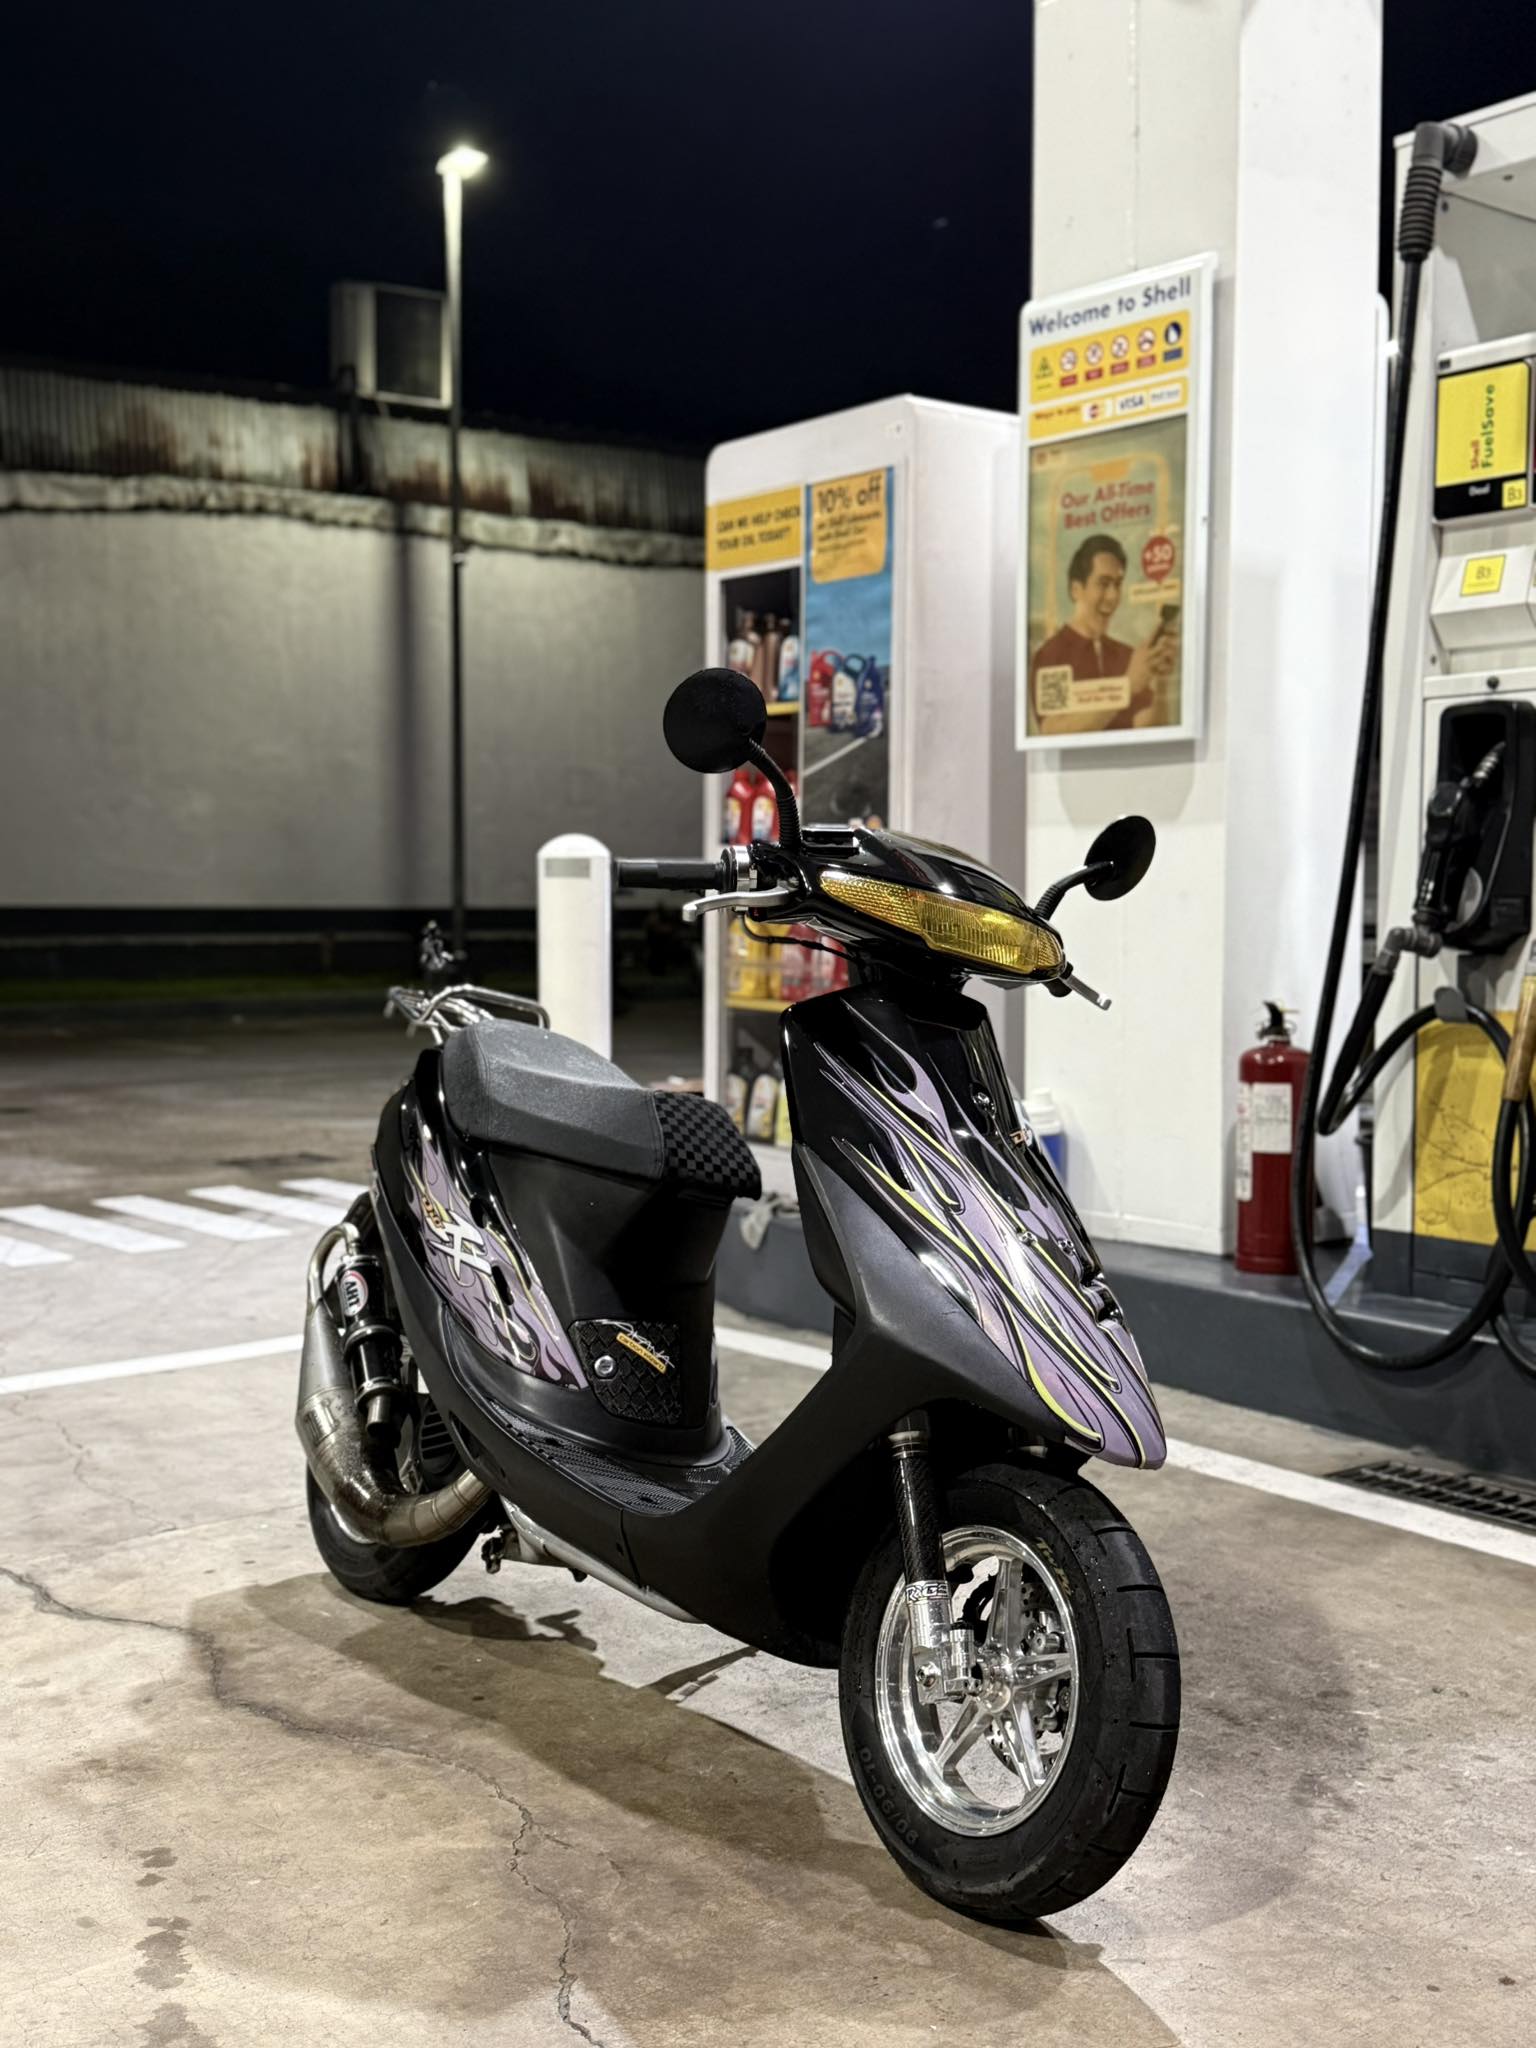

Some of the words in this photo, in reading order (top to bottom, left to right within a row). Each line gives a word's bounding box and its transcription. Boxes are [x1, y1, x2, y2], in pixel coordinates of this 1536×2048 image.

[1028, 304, 1111, 336] Welcome
[1117, 296, 1137, 314] to
[1142, 275, 1191, 307] Shell
[1481, 384, 1495, 469] FuelSave
[817, 486, 852, 514] 10%
[857, 474, 882, 506] off
[1061, 492, 1089, 509] Our
[1064, 511, 1096, 529] Best
[1101, 503, 1151, 524] Offers
